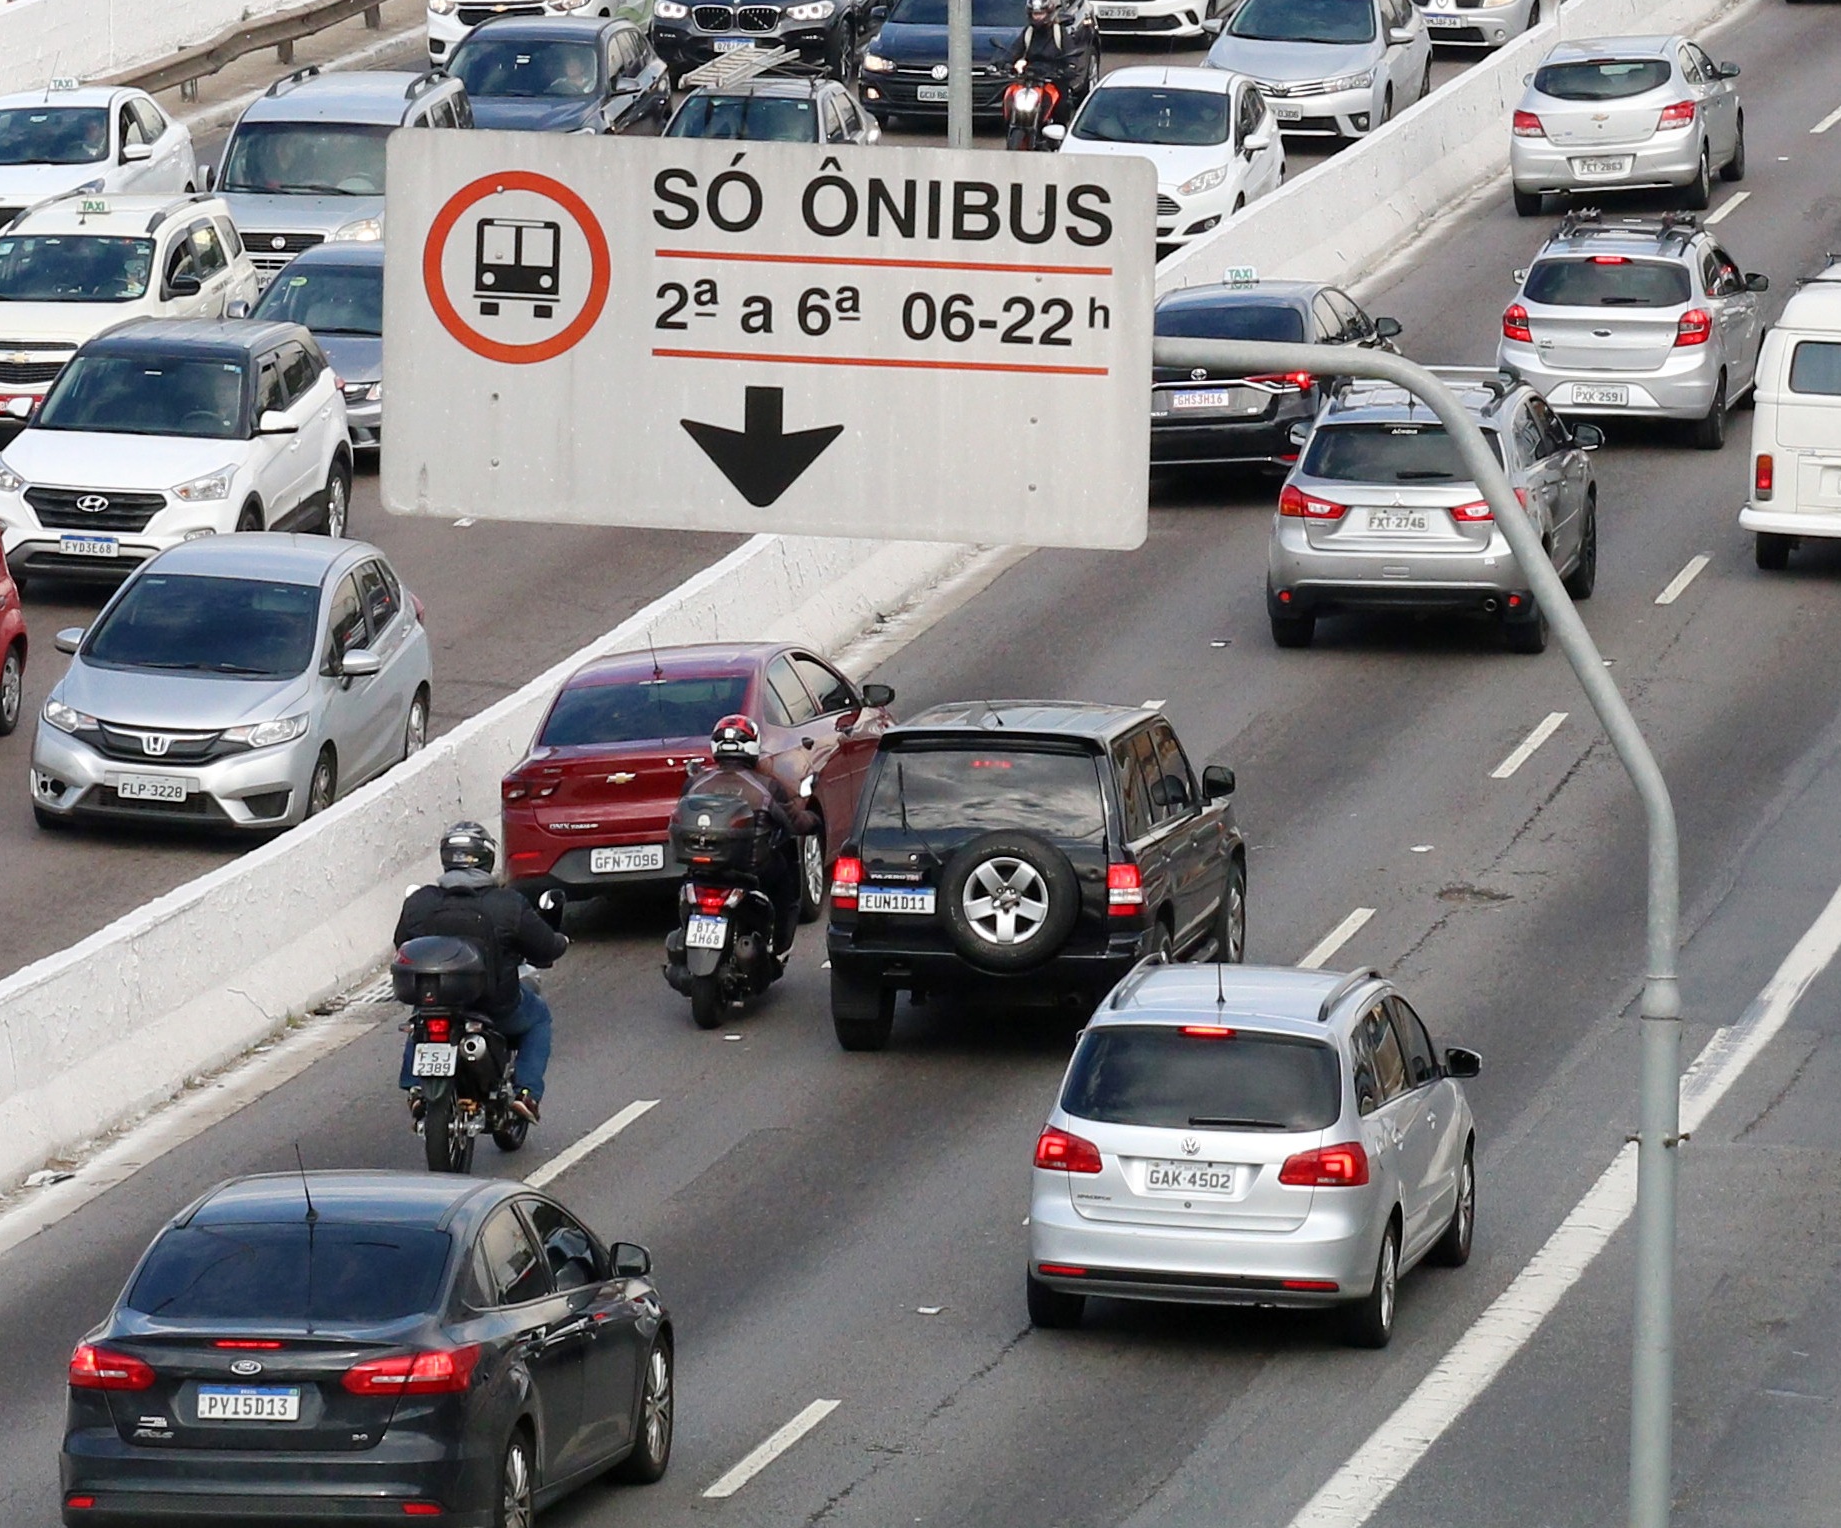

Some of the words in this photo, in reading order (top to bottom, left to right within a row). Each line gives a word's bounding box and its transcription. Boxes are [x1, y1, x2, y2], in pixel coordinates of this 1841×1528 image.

[653, 154, 763, 232] SÓ
[802, 157, 1113, 246] ÔNIBUS
[1228, 269, 1252, 280] TAXI
[655, 279, 719, 331] 2ª
[740, 296, 773, 335] a
[797, 286, 861, 336] 6ª
[65, 543, 112, 554] FYD3E68
[866, 895, 926, 910] EUN1D11
[420, 1052, 451, 1062] FSJ
[417, 1063, 451, 1074] 2389
